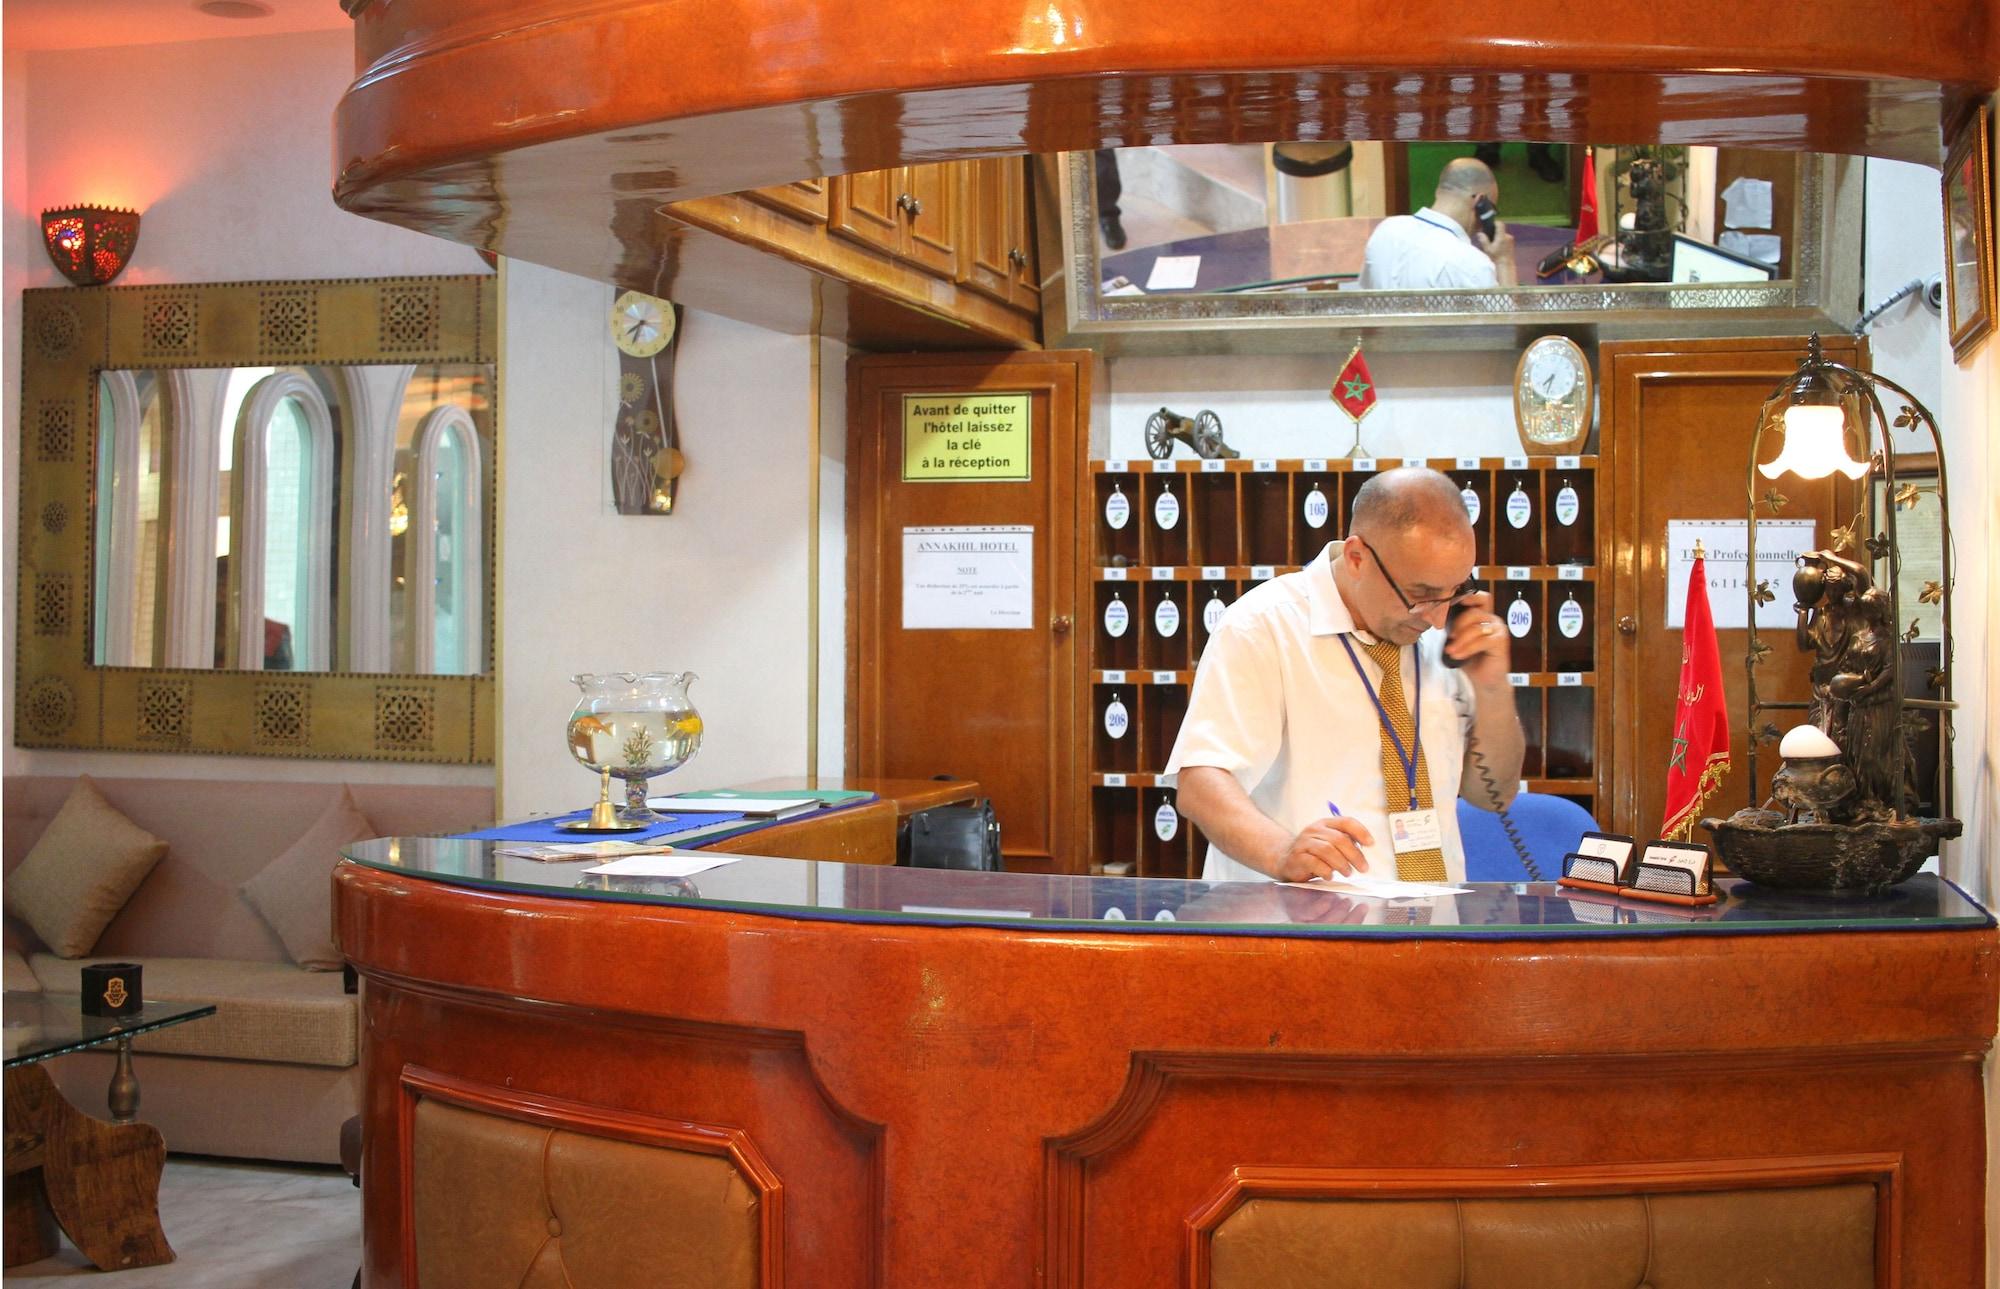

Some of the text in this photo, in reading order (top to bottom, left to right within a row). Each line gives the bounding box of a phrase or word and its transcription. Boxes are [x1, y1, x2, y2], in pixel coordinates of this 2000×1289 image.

[913, 403, 1016, 417] Avant de quitter
[924, 421, 1013, 433] l'hôtel laissez
[947, 438, 982, 450] la clé
[922, 456, 1010, 470] à la réception
[1310, 503, 1326, 516] 105
[918, 542, 1018, 551] ANNAKHIL HOTEL
[1714, 550, 1800, 560] Profesionnelle
[1511, 612, 1529, 625] 206
[1108, 714, 1126, 726] 208
